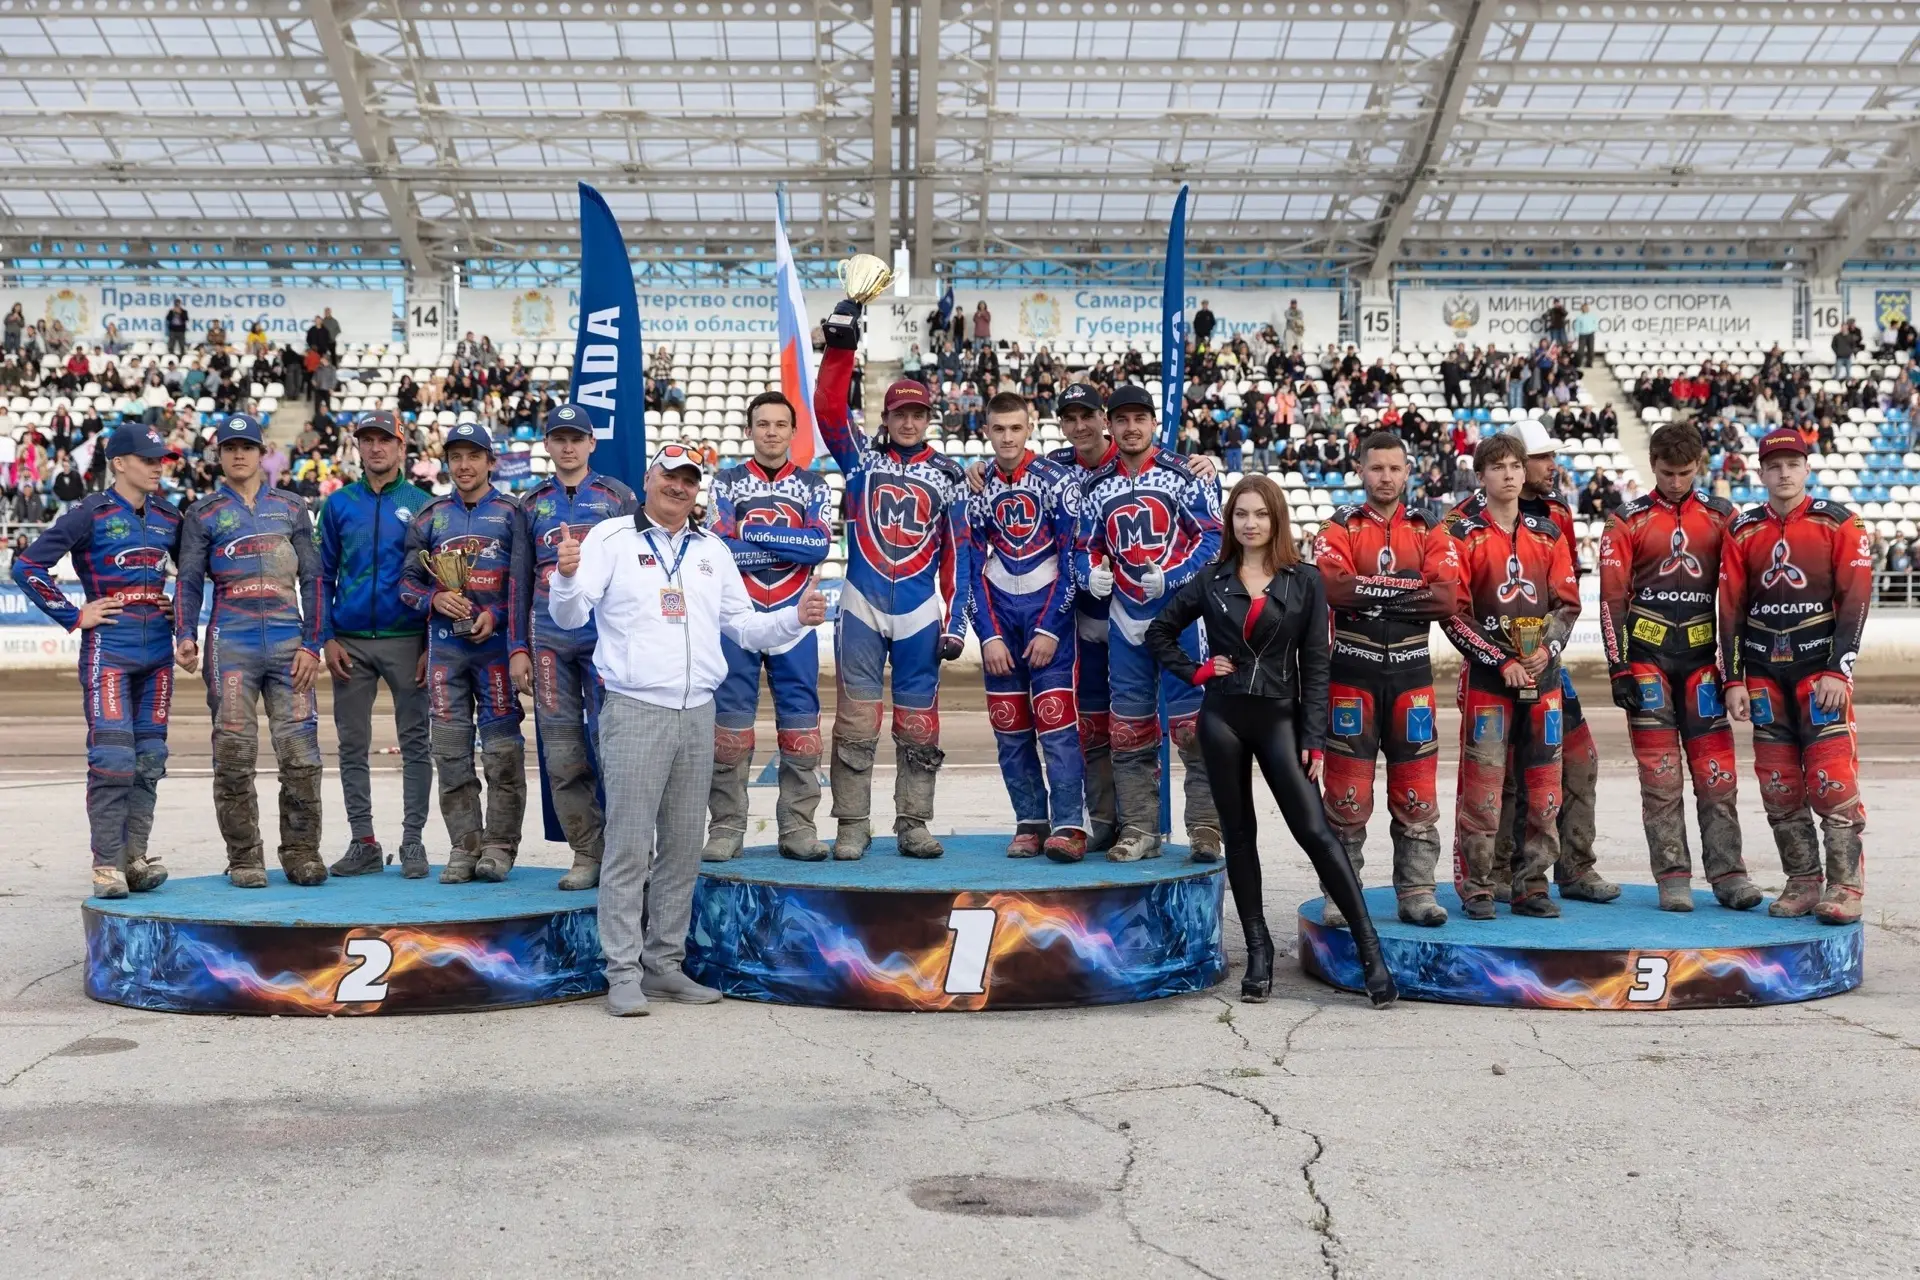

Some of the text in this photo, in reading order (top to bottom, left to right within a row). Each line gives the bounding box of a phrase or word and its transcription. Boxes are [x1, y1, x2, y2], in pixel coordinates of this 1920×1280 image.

[101, 288, 286, 310] Правительство
[1654, 294, 1732, 311] СПОРТА
[411, 306, 438, 327] 14
[1363, 311, 1389, 332] 15
[1632, 317, 1751, 335] ФЕДЕРАЦИИ
[1813, 308, 1838, 328] 16
[577, 305, 620, 440] LADA
[1114, 508, 1166, 551] ML
[1657, 590, 1712, 603] ФОСАГРО
[1761, 602, 1824, 615] ФОСАГРО
[944, 907, 997, 995] 1
[334, 937, 394, 1003] 2
[1627, 956, 1670, 1003] 3
